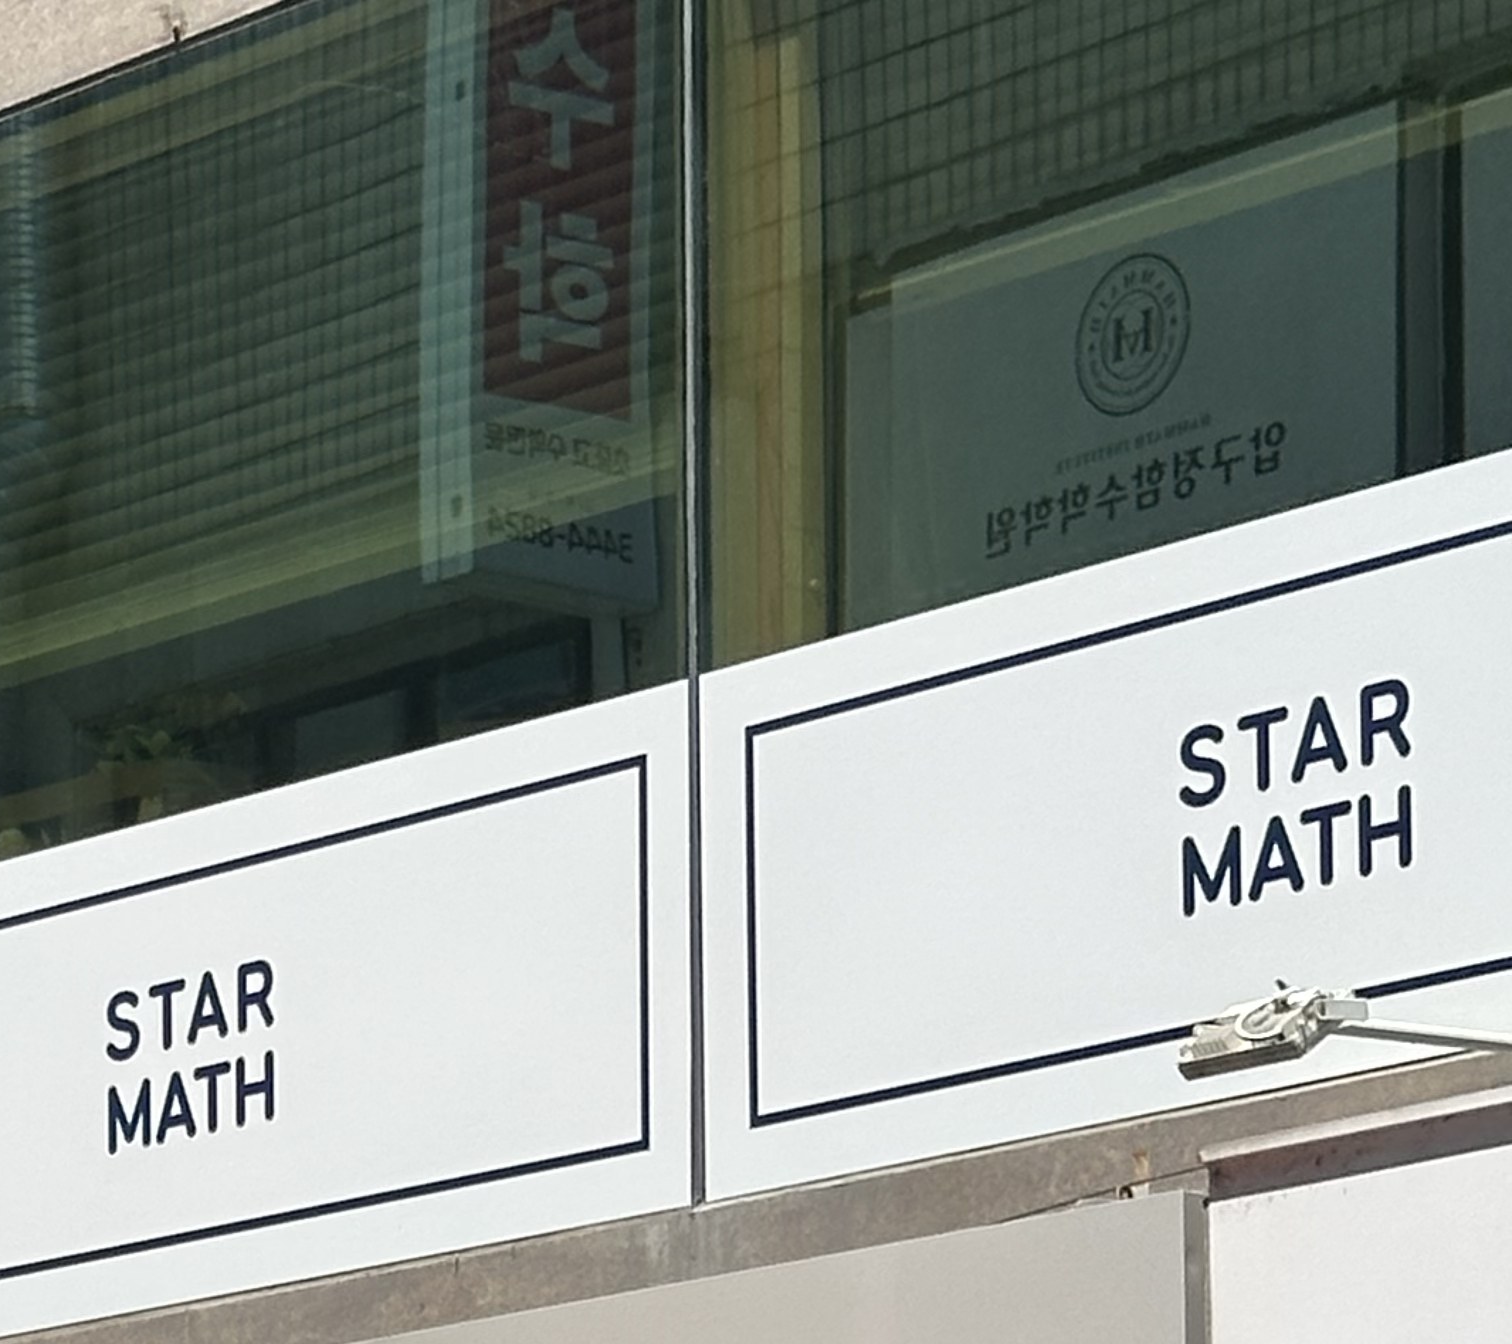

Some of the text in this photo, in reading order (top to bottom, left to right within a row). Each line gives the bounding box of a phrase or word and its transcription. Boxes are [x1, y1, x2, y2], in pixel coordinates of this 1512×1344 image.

[1180, 680, 1411, 808] STAR
[1182, 786, 1412, 917] MATH
[106, 960, 274, 1062] STAR
[108, 1051, 275, 1155] MATH
